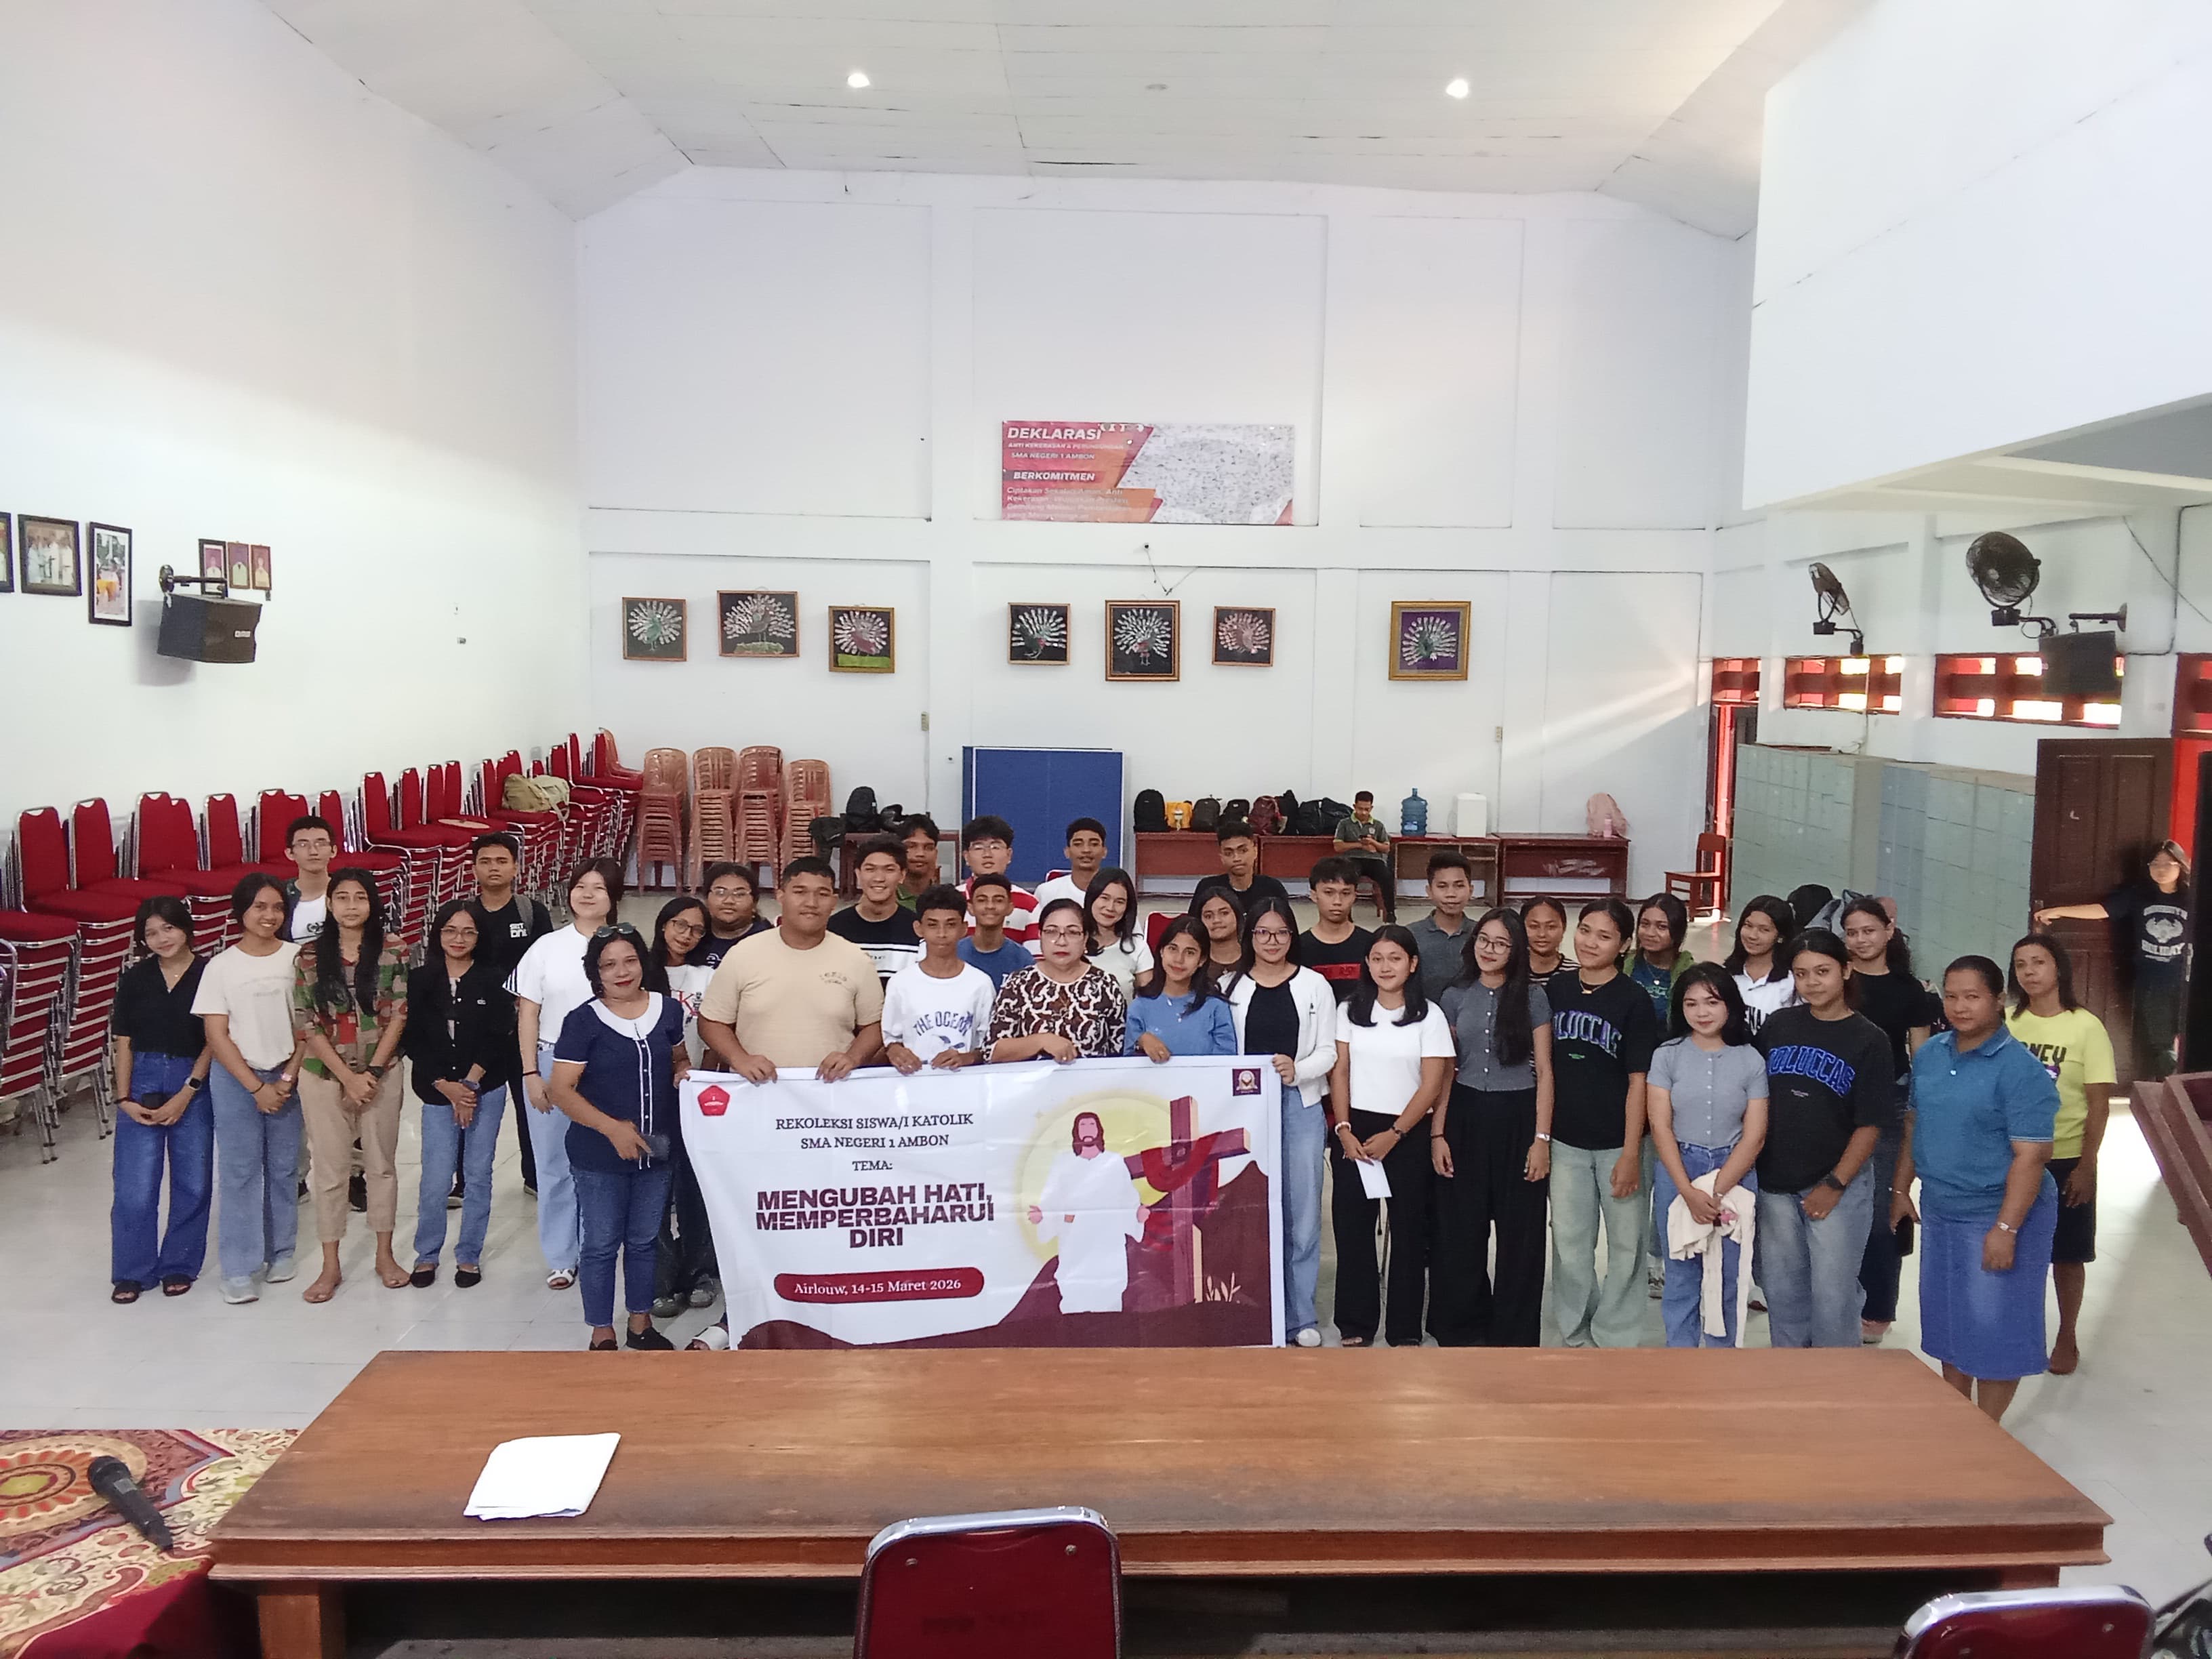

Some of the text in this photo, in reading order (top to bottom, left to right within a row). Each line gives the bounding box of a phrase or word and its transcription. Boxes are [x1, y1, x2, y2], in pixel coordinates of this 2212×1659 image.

[1007, 427, 1101, 440] DEKLARASI
[1013, 472, 1095, 480] BERKOMITMEN
[913, 1014, 934, 1036] THE
[2022, 1042, 2067, 1067] NEY
[1768, 1045, 1856, 1098] OLUCCAS
[775, 1113, 974, 1130] REKOLEKSI SISWA/I KATOLIK
[801, 1134, 949, 1149] SMA NEGERI 1 AMBON
[852, 1160, 893, 1171] TEMA:
[757, 1183, 992, 1210] MENGUBAH HATI,
[756, 1202, 995, 1231] MEMPERBAHARUI
[850, 1227, 903, 1248] DIRI
[794, 1279, 962, 1296] Airlouw, 14-15 Maret 2026
